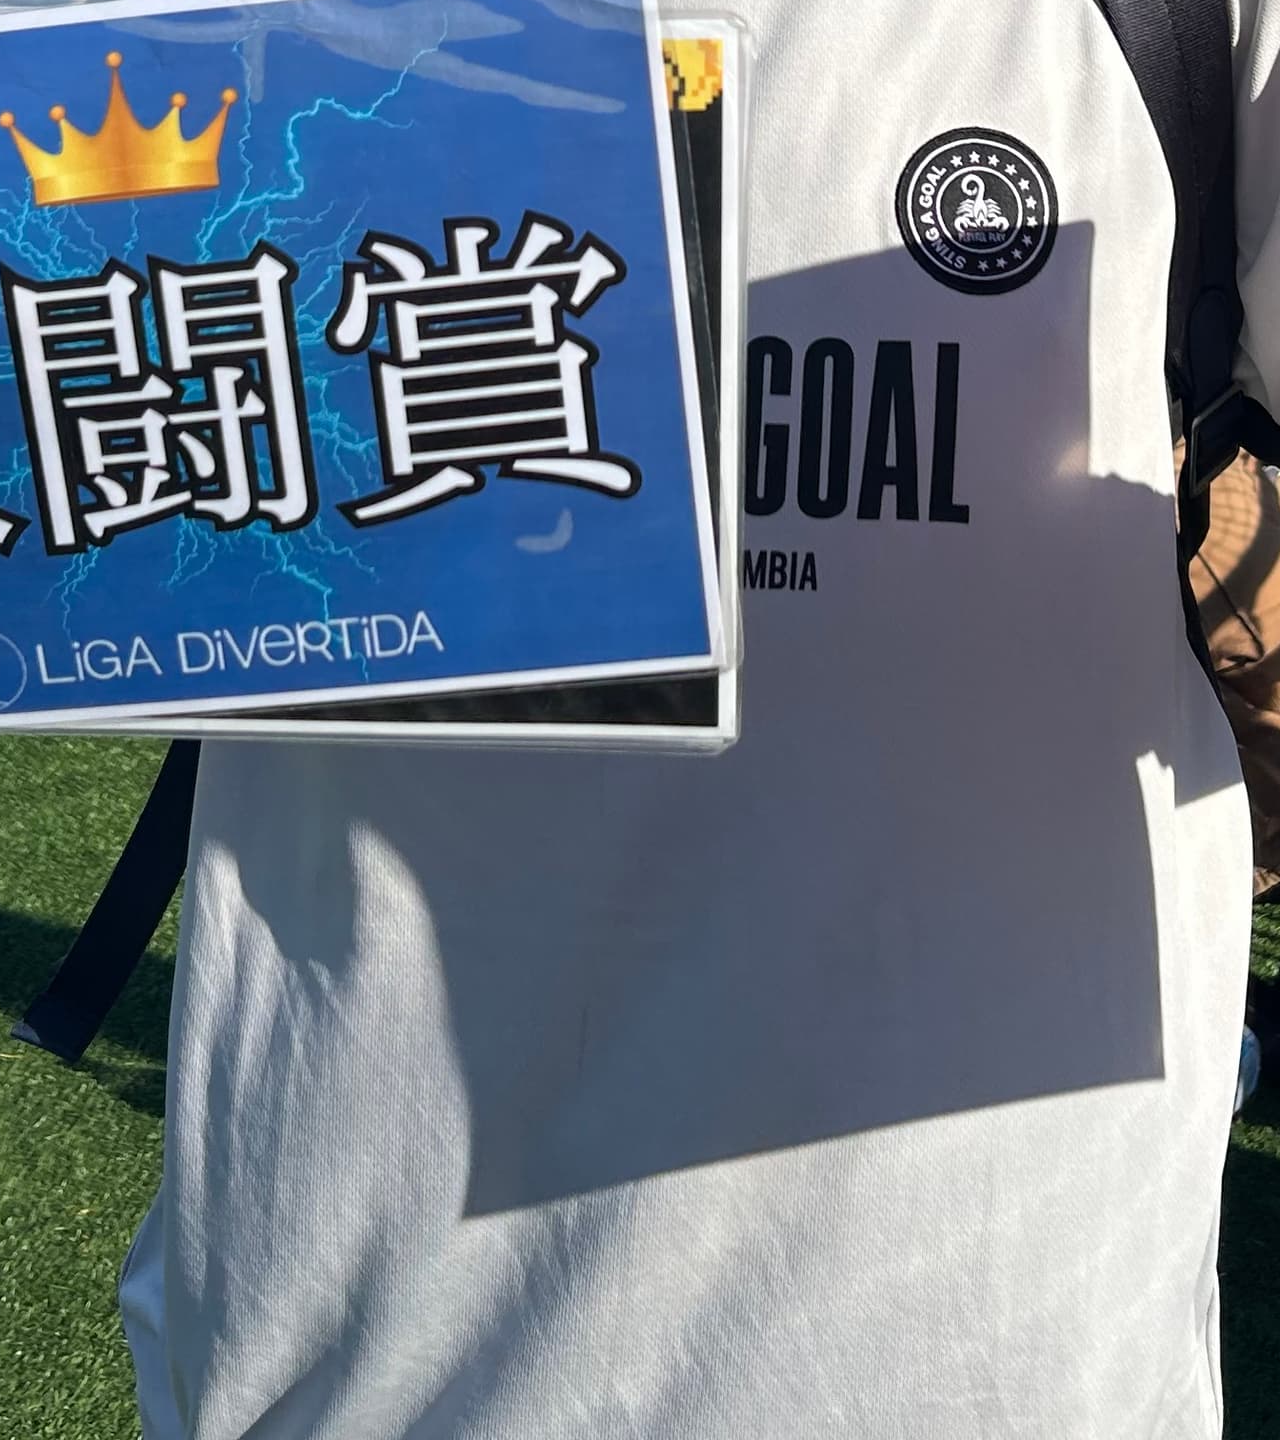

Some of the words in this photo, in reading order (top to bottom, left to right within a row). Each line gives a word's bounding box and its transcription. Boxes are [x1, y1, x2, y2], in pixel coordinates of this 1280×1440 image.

[918, 164, 948, 209] GOAL
[924, 226, 967, 270] STING
[744, 335, 970, 524] GOAL
